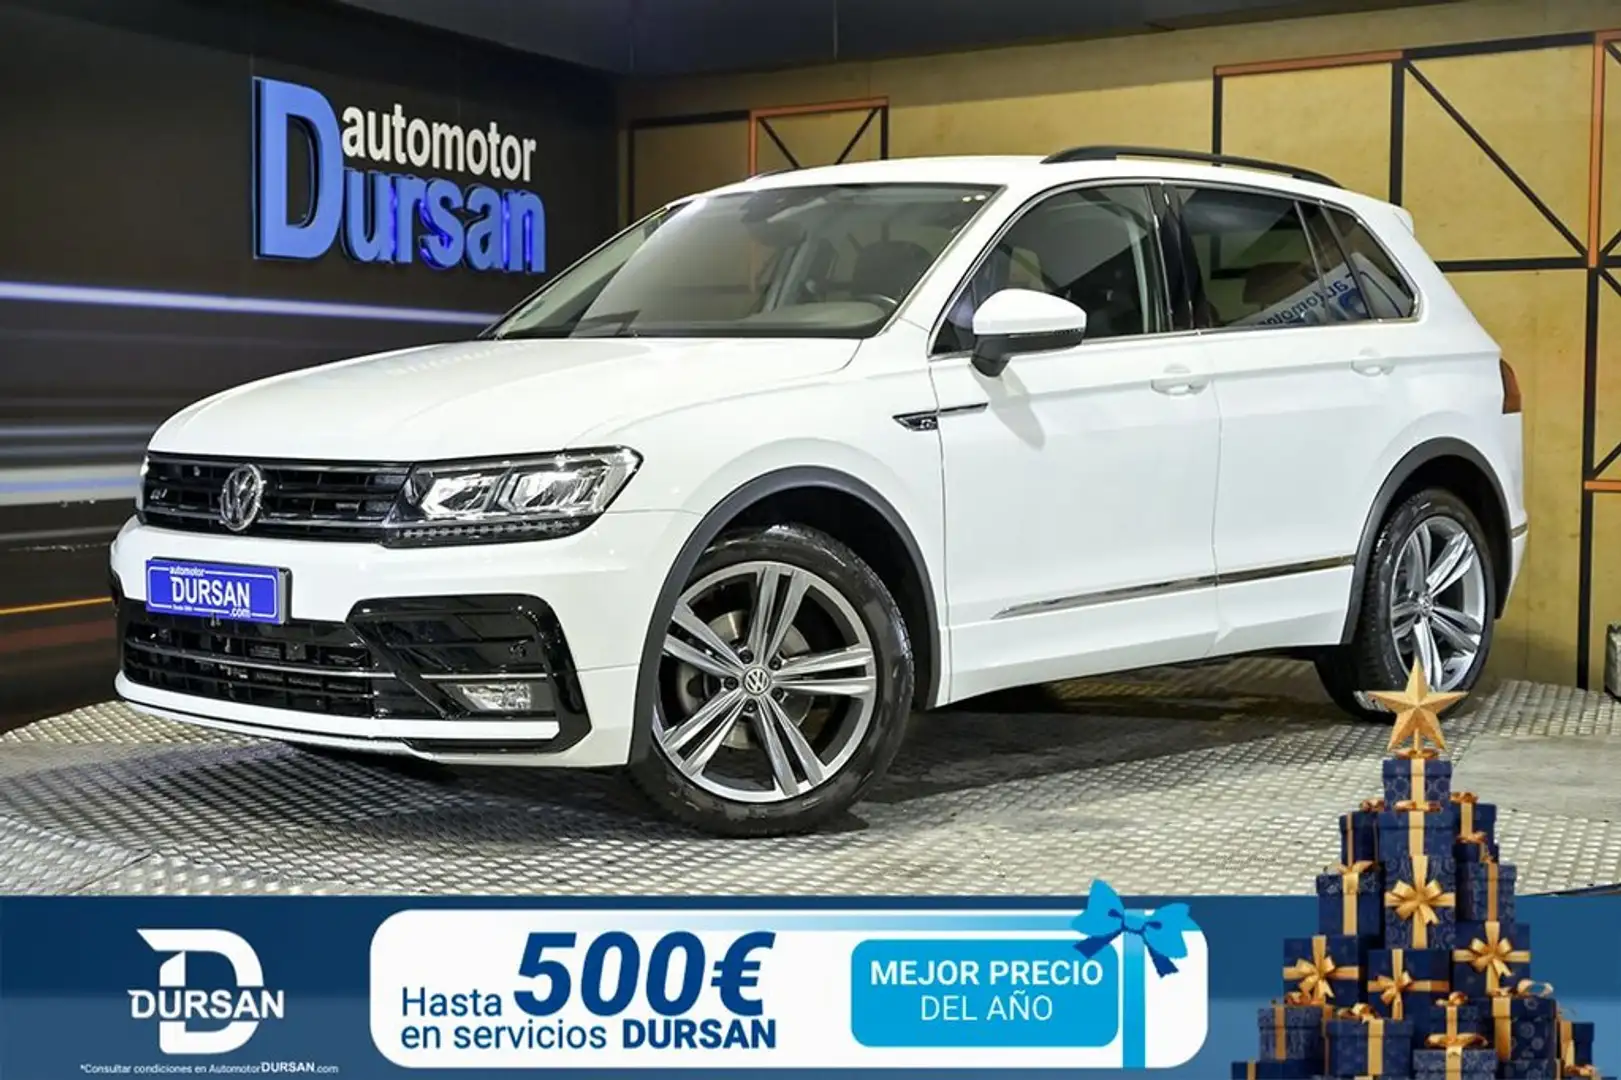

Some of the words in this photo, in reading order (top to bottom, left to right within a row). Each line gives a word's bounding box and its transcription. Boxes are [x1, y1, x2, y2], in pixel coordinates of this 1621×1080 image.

[342, 104, 536, 182] automotor
[252, 76, 546, 274] Dursan
[170, 576, 251, 608] DURSAN
[230, 607, 251, 619] .com
